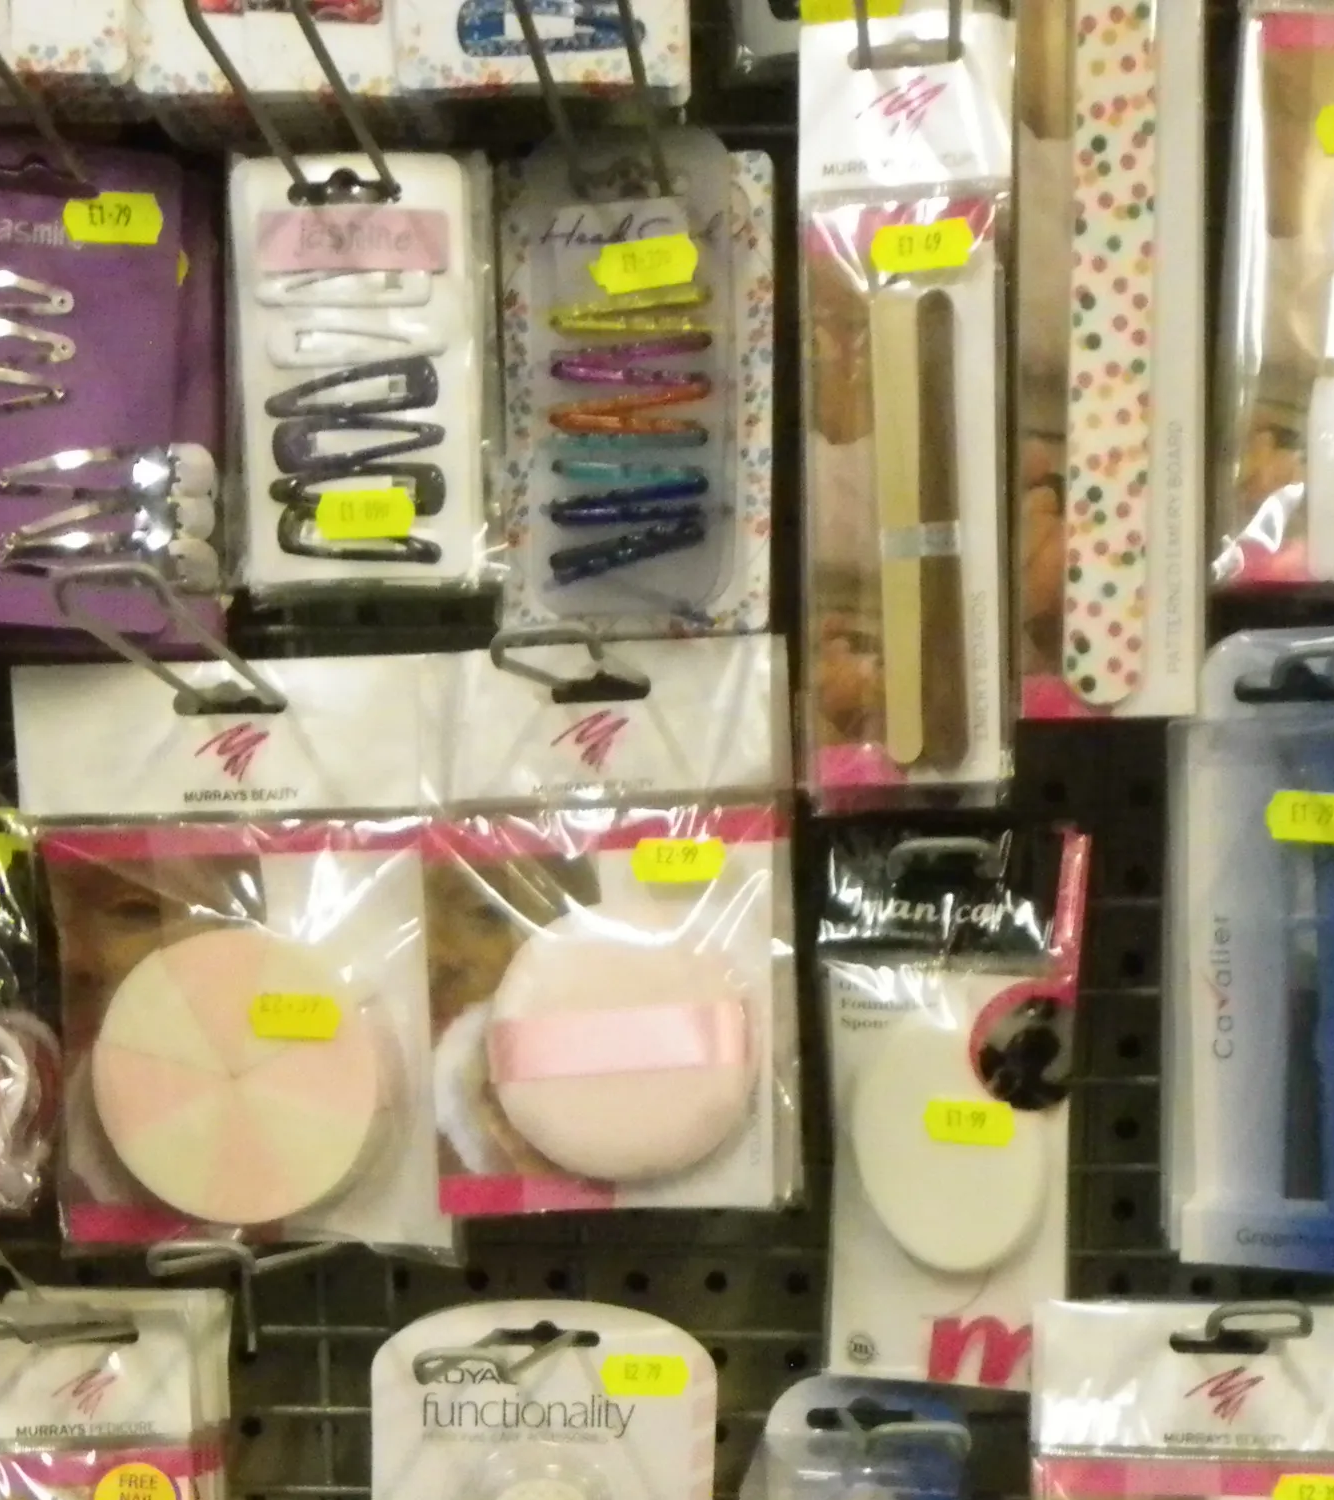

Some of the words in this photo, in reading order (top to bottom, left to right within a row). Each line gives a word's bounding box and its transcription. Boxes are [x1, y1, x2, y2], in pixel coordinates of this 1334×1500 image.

[183, 788, 250, 804] MURRAYS
[252, 786, 299, 802] BEAUTY
[1212, 911, 1234, 1062] Cavalier
[421, 1391, 637, 1440] functionality
[14, 1423, 86, 1438] MURRAYS
[118, 1473, 158, 1490] FREE
